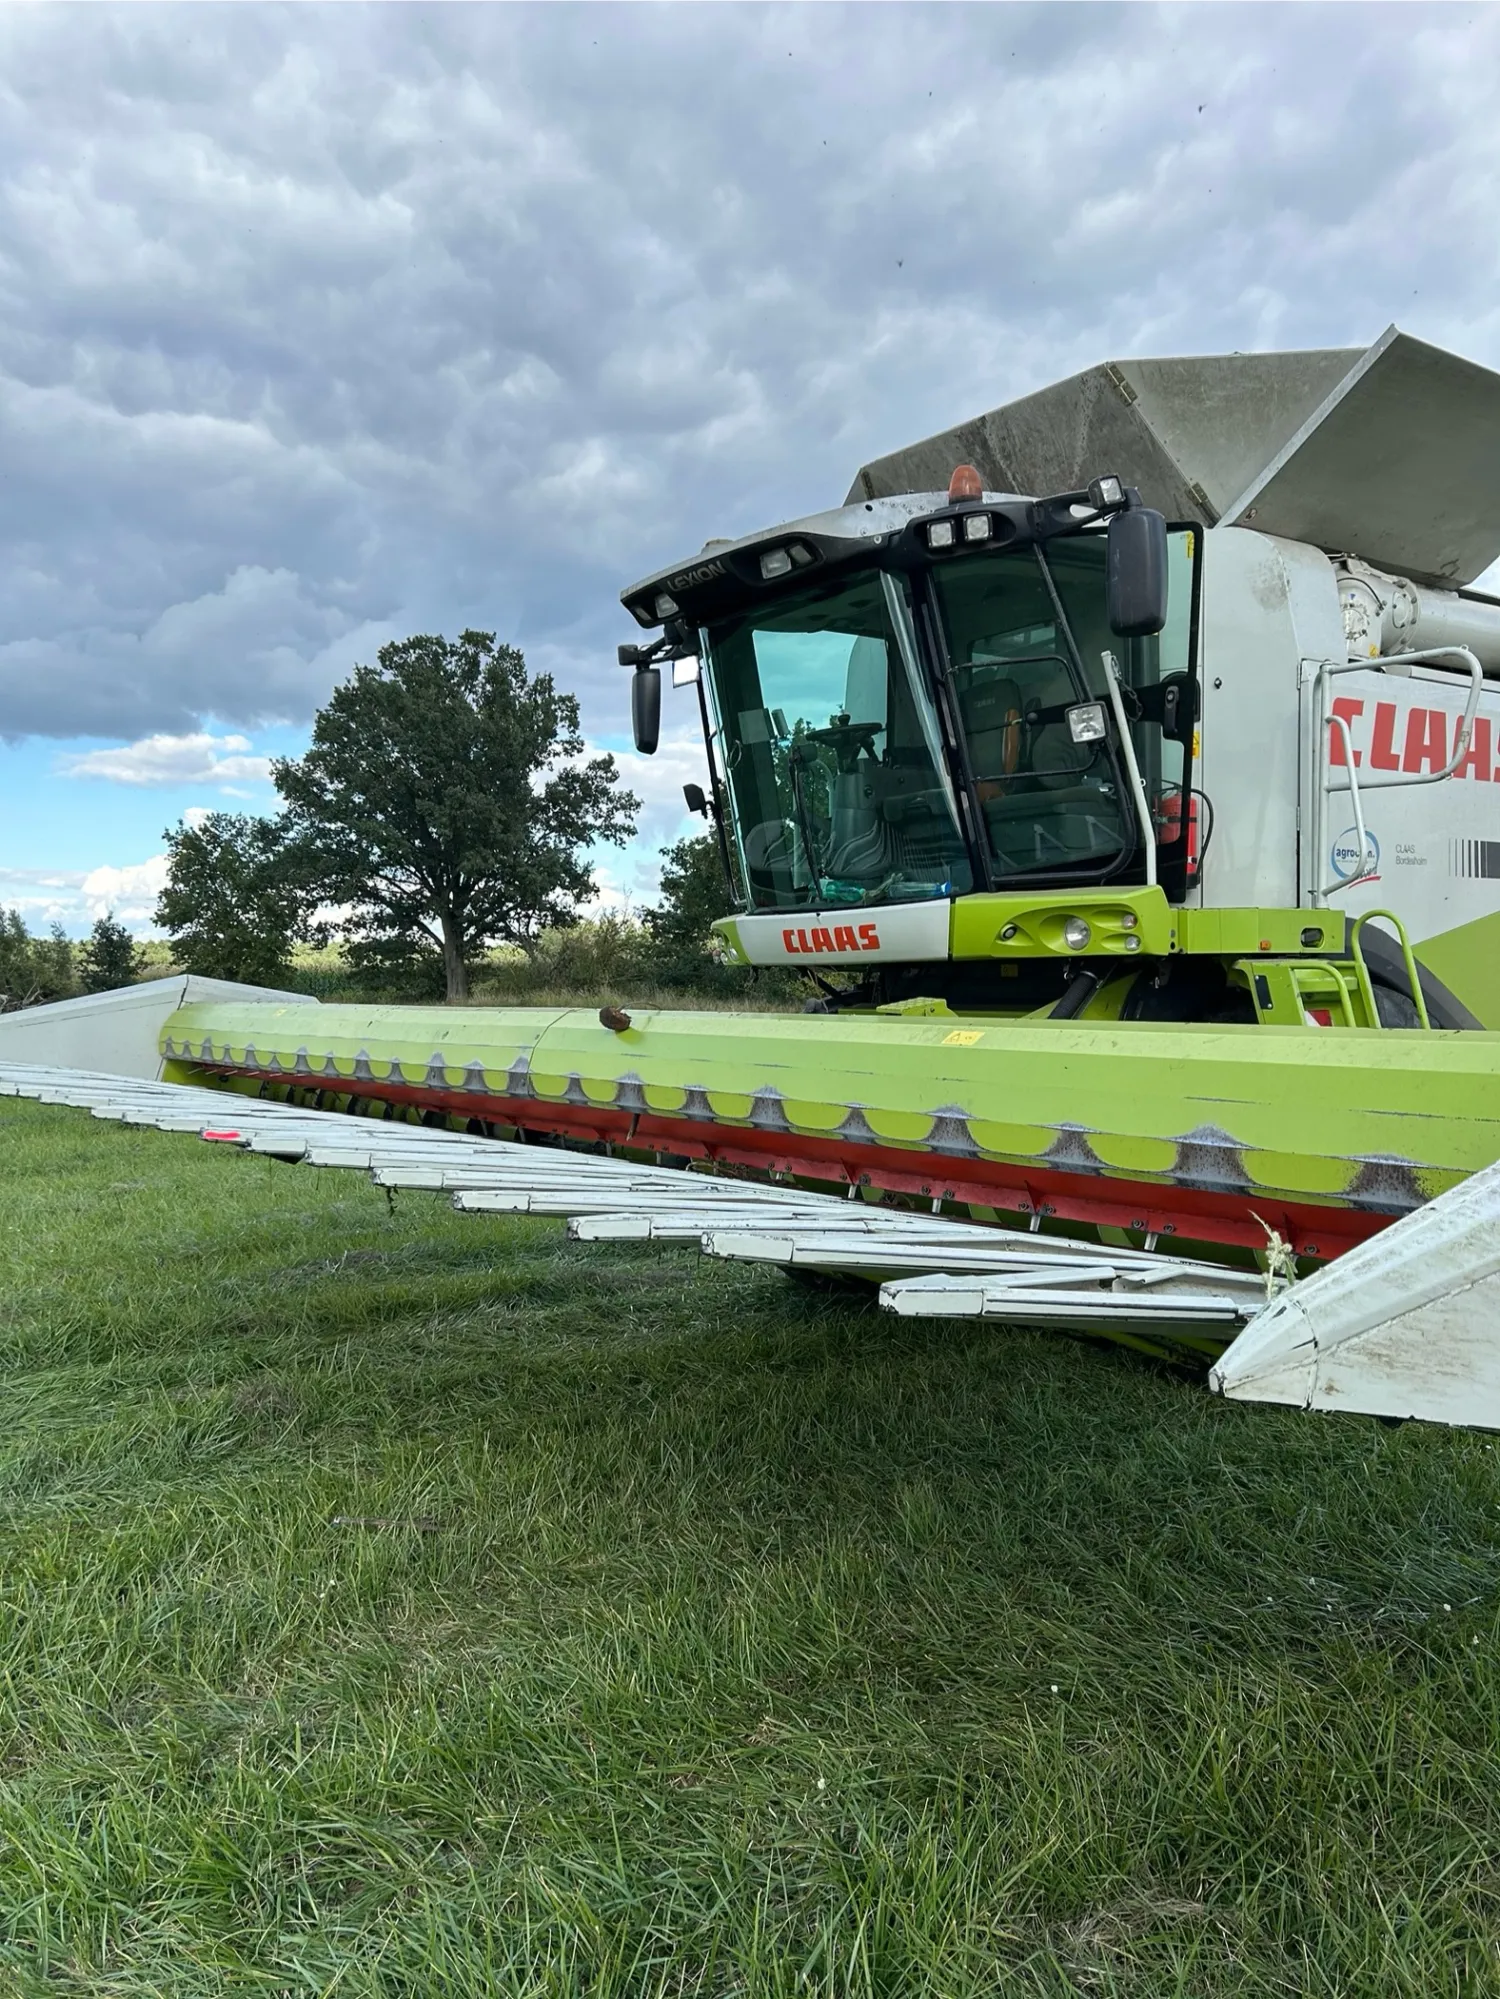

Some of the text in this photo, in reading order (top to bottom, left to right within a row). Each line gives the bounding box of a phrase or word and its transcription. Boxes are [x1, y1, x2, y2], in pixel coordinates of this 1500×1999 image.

[667, 560, 727, 592] LEXION
[1330, 697, 1500, 783] CLAA
[1395, 843, 1416, 854] CLAAS
[782, 923, 881, 954] CLAAS
